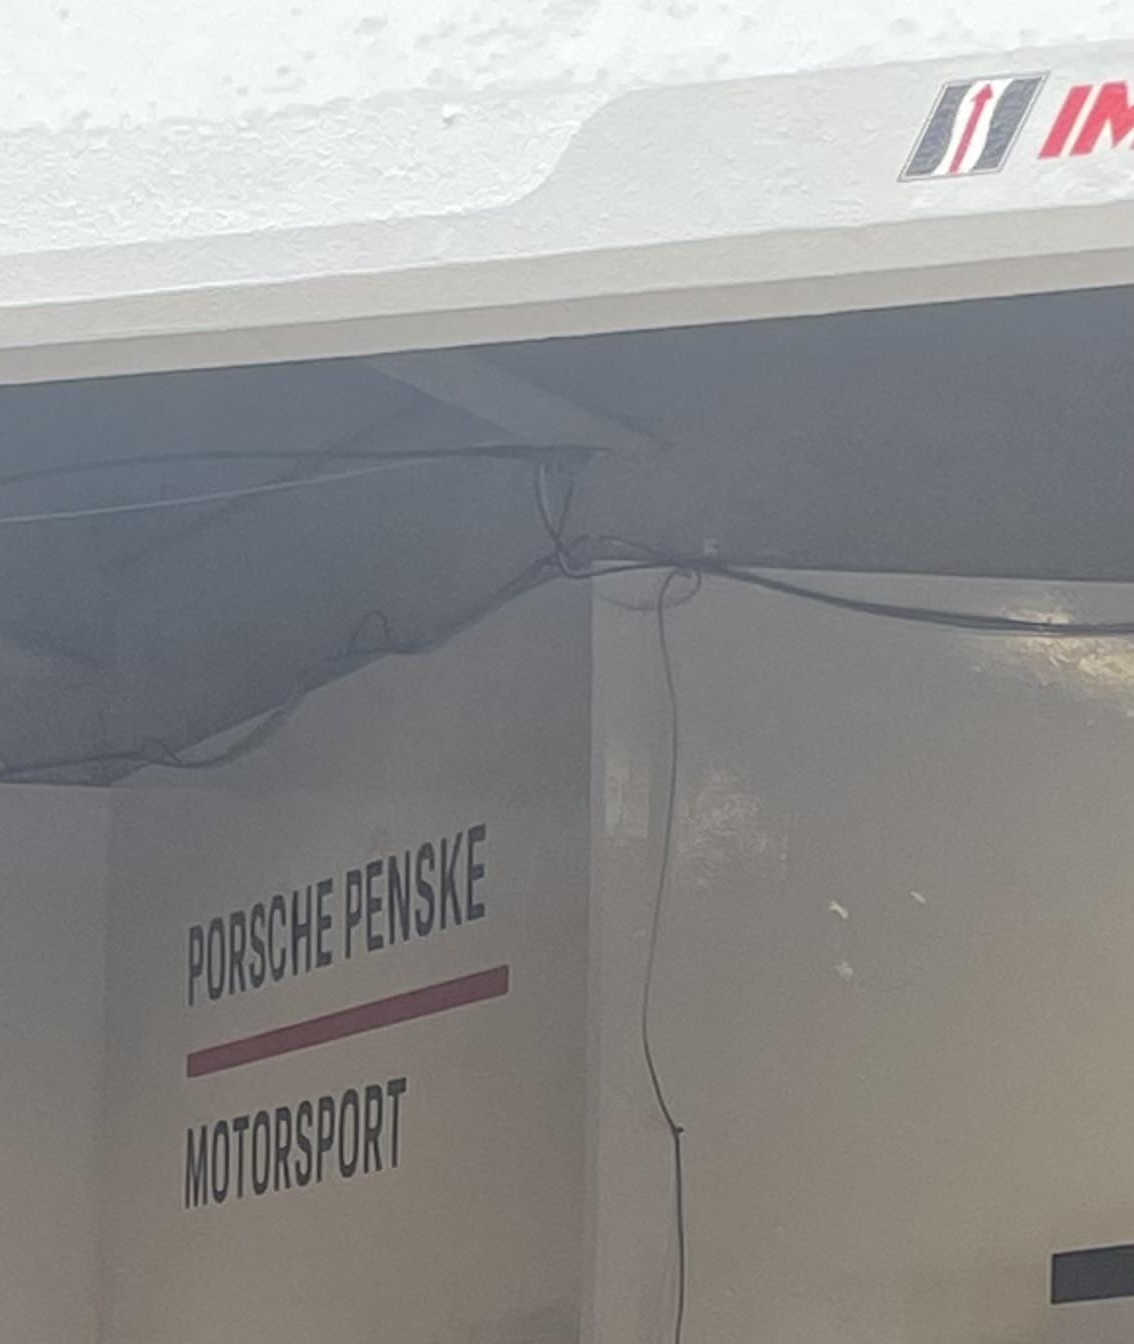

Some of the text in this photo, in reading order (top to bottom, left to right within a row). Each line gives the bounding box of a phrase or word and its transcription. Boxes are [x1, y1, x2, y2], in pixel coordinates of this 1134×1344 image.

[188, 823, 486, 1007] PORSCHE PENSKE
[184, 1077, 407, 1209] MOTORSPORT
